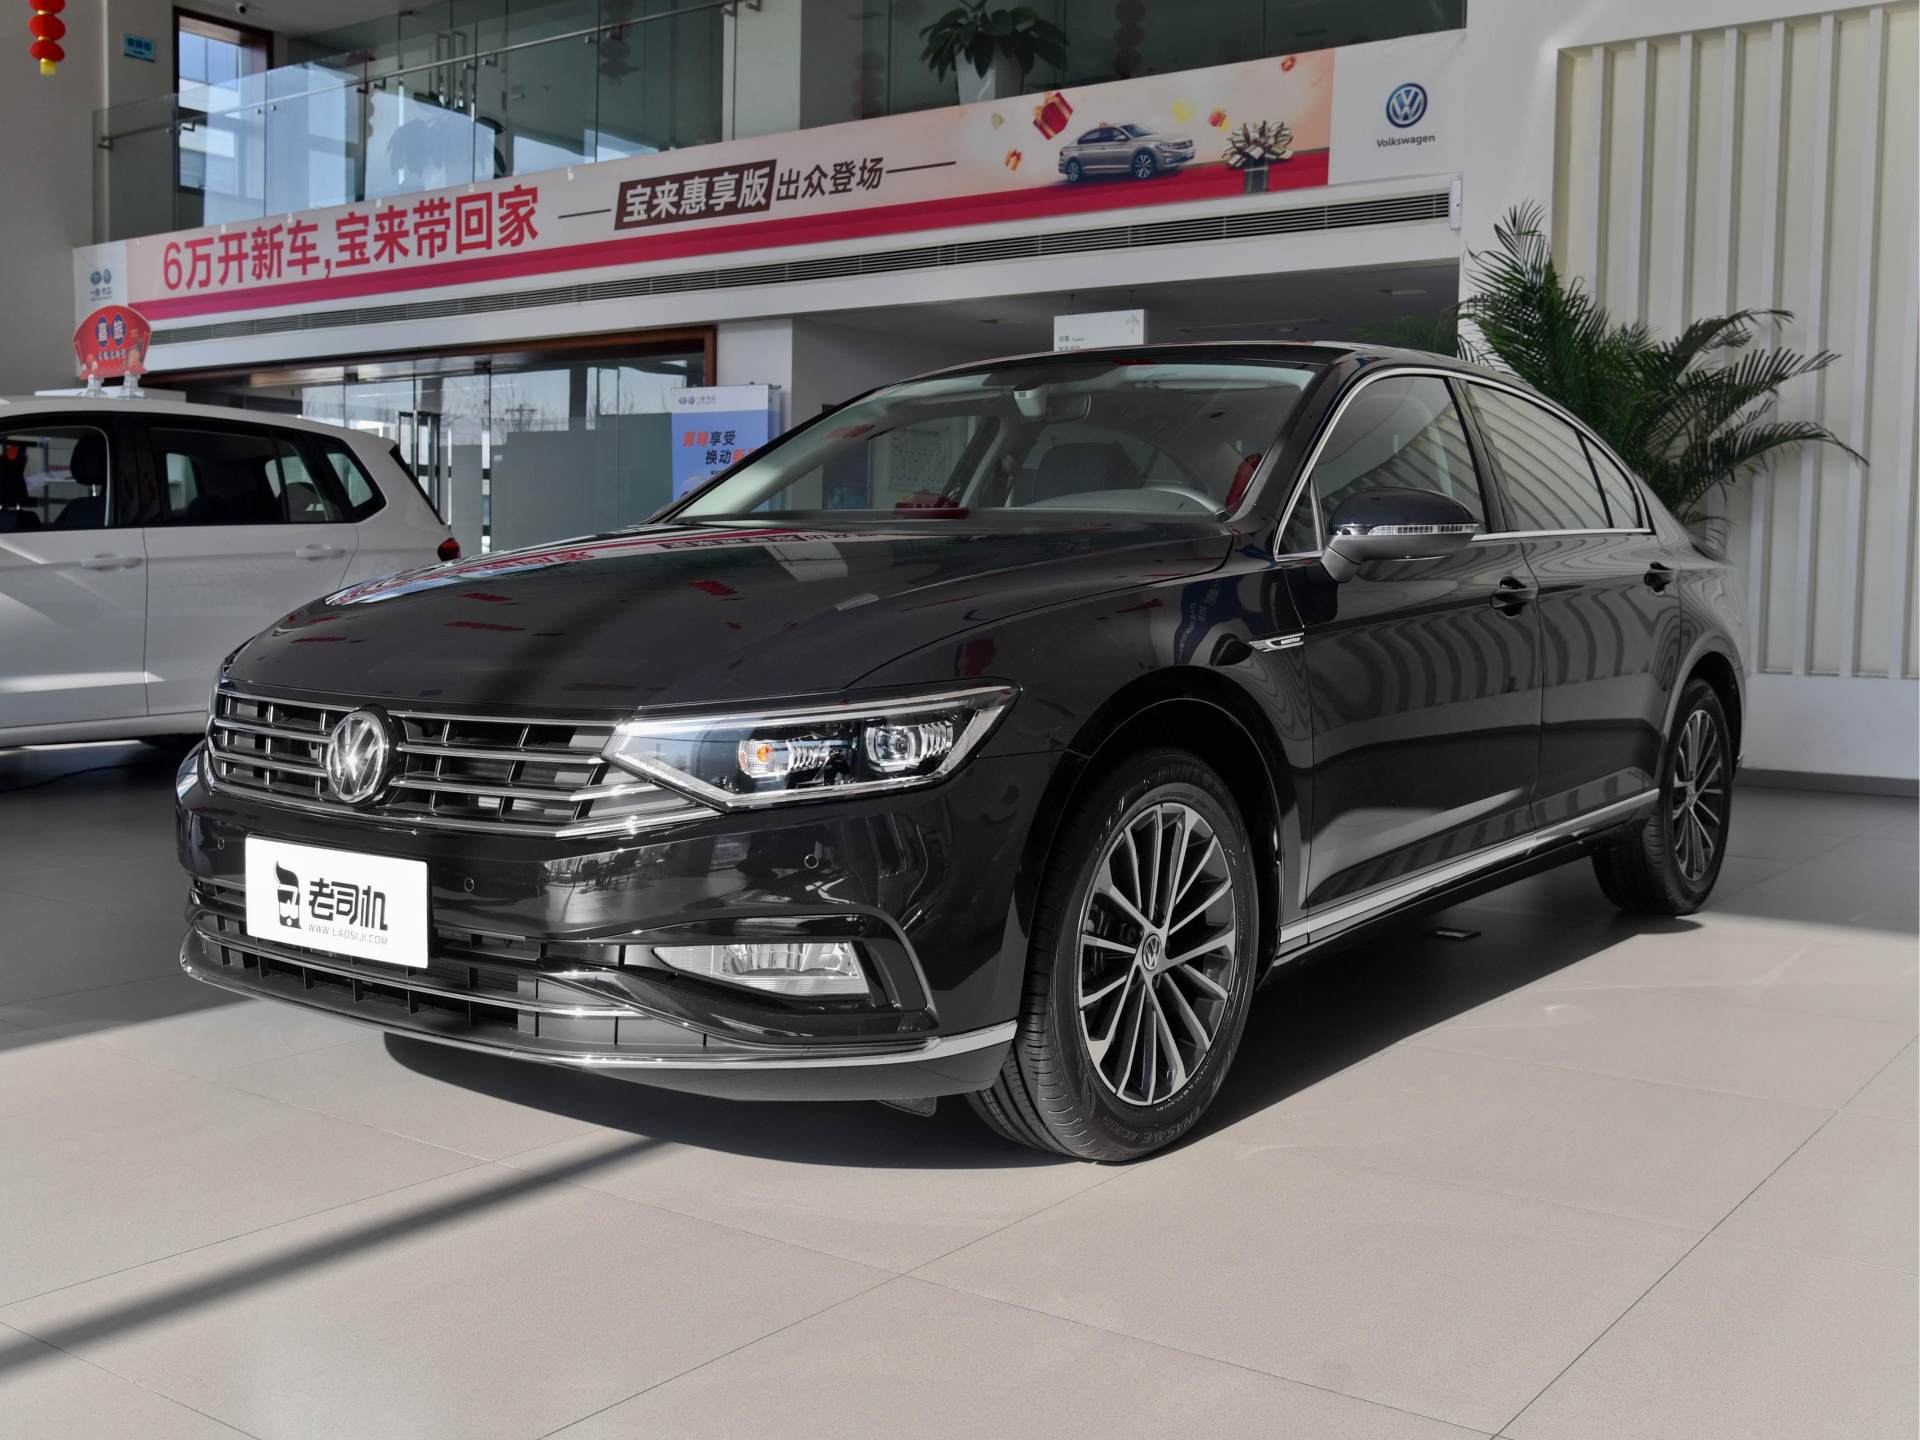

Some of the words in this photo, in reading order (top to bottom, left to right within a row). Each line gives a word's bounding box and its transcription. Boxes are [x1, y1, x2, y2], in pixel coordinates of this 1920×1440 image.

[1377, 135, 1436, 147] Volkswagen
[622, 166, 770, 223] 宝来惠享版
[776, 157, 883, 201] 出众登场
[308, 878, 388, 931] 老司机
